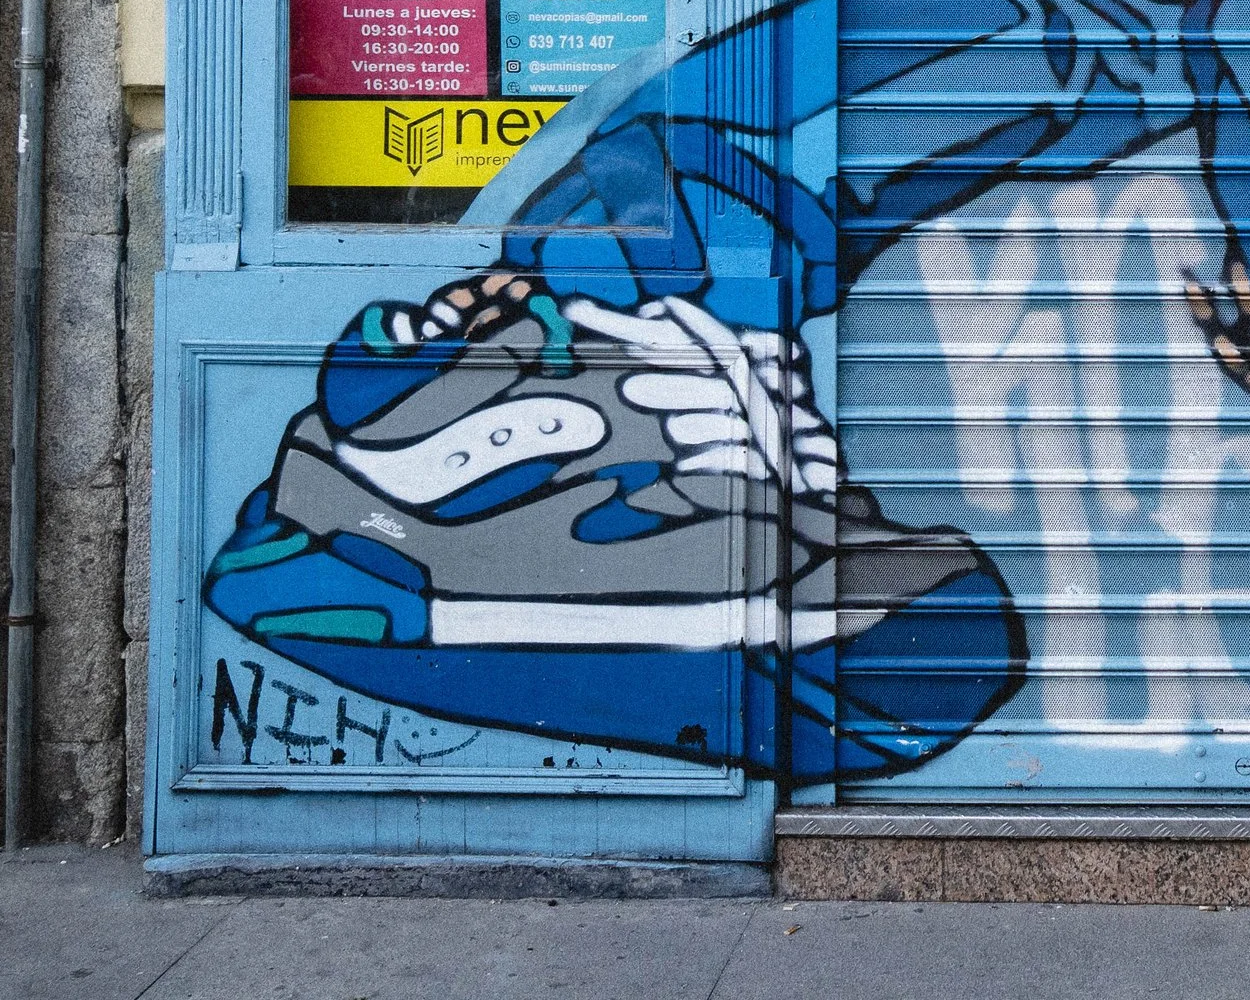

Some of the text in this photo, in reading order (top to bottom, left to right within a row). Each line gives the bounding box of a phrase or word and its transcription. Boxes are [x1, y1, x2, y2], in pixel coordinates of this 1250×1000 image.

[343, 6, 477, 21] Lunes a jueves:
[528, 12, 648, 24] nevacopias@gmail.com
[361, 24, 459, 36] 09:30-14:00
[362, 42, 460, 54] 16:30-20:00
[528, 35, 615, 49] 639 713 407
[351, 60, 470, 73] Viernes tarde:
[528, 60, 620, 74] @suministrosne
[363, 78, 460, 91] 16:30-19:00
[456, 152, 515, 168] impren
